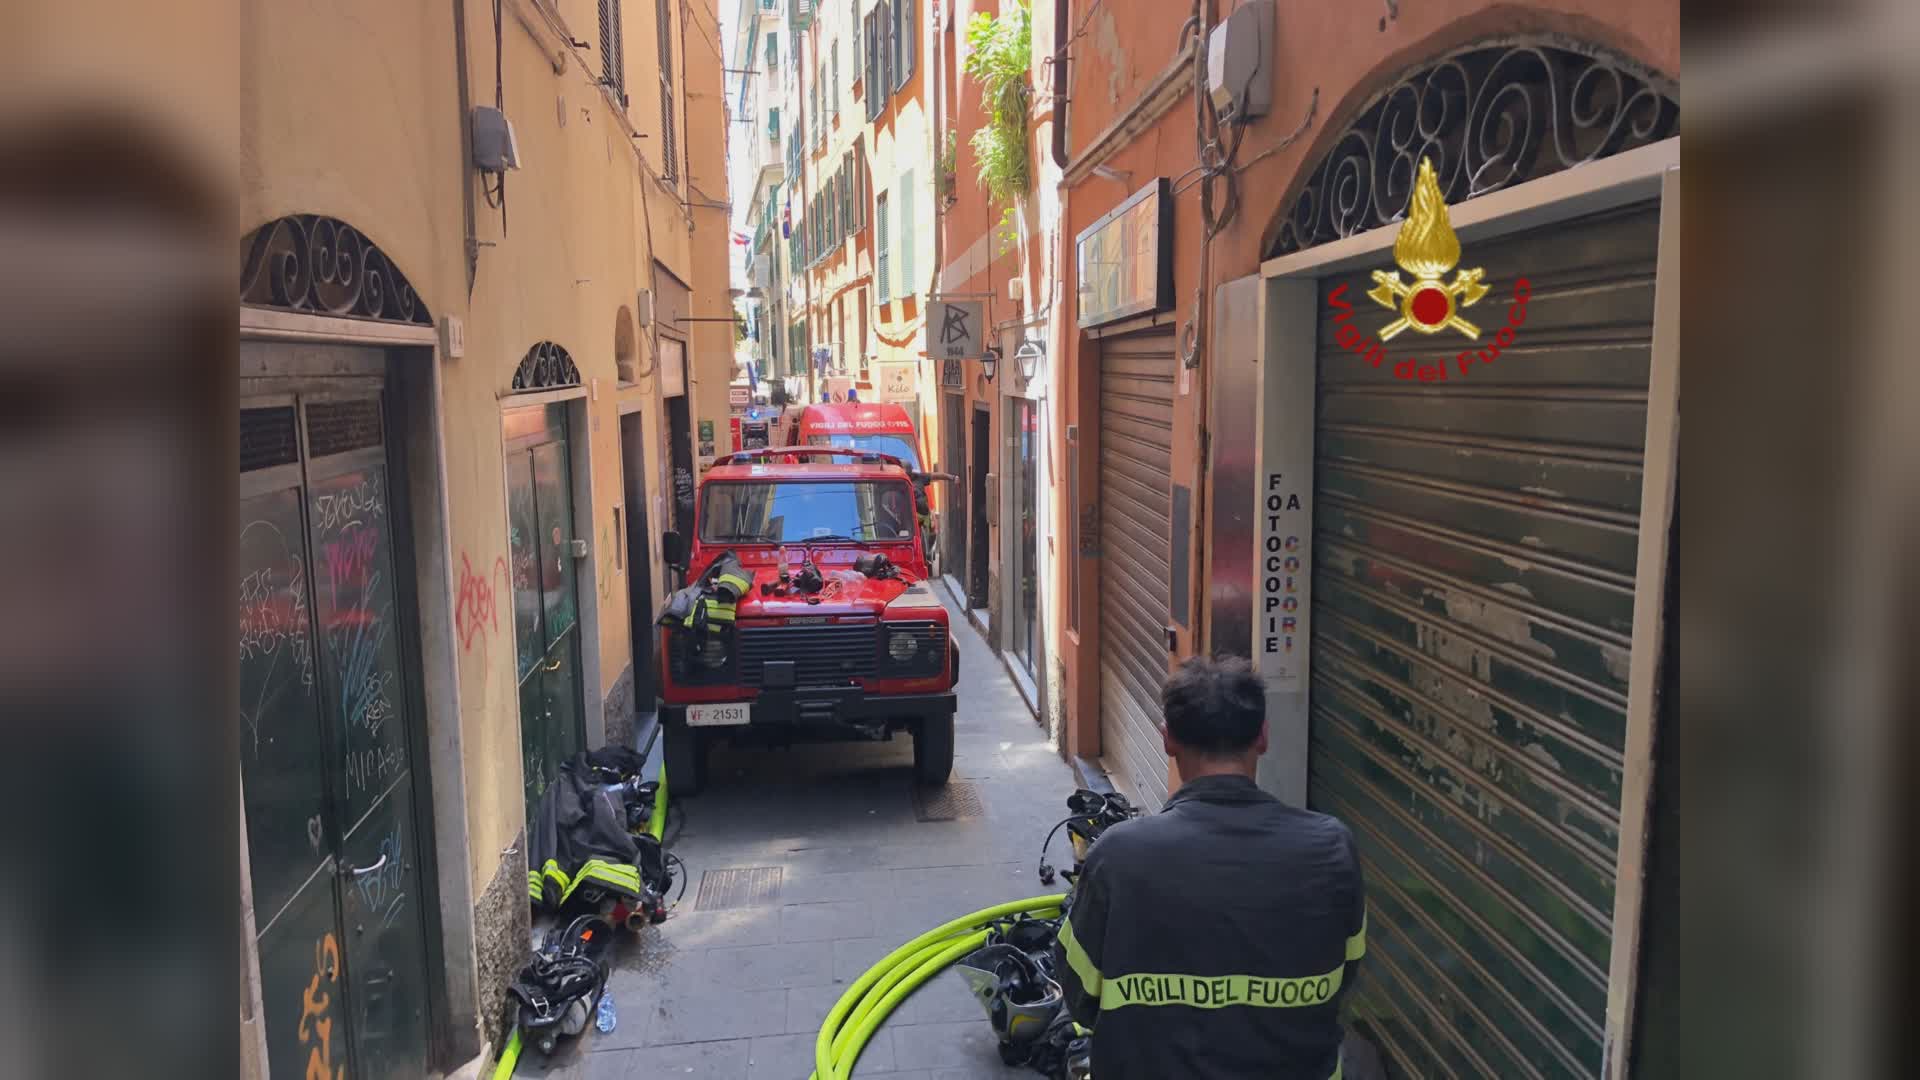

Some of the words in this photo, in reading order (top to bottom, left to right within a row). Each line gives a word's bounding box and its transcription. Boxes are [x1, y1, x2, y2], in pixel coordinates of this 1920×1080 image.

[887, 384, 910, 393] Kilo
[809, 421, 835, 430] VIGILI
[837, 421, 854, 429] DEL
[855, 420, 886, 429] FUOCO
[1286, 494, 1300, 510] A
[1265, 474, 1282, 653] FOTOCOPIE
[1281, 536, 1300, 655] COLORI
[690, 710, 704, 720] VF
[713, 709, 743, 720] 21531
[1116, 976, 1185, 1001] VIGILI
[1192, 978, 1239, 1005] DEL
[1247, 977, 1330, 1005] FUOCO
